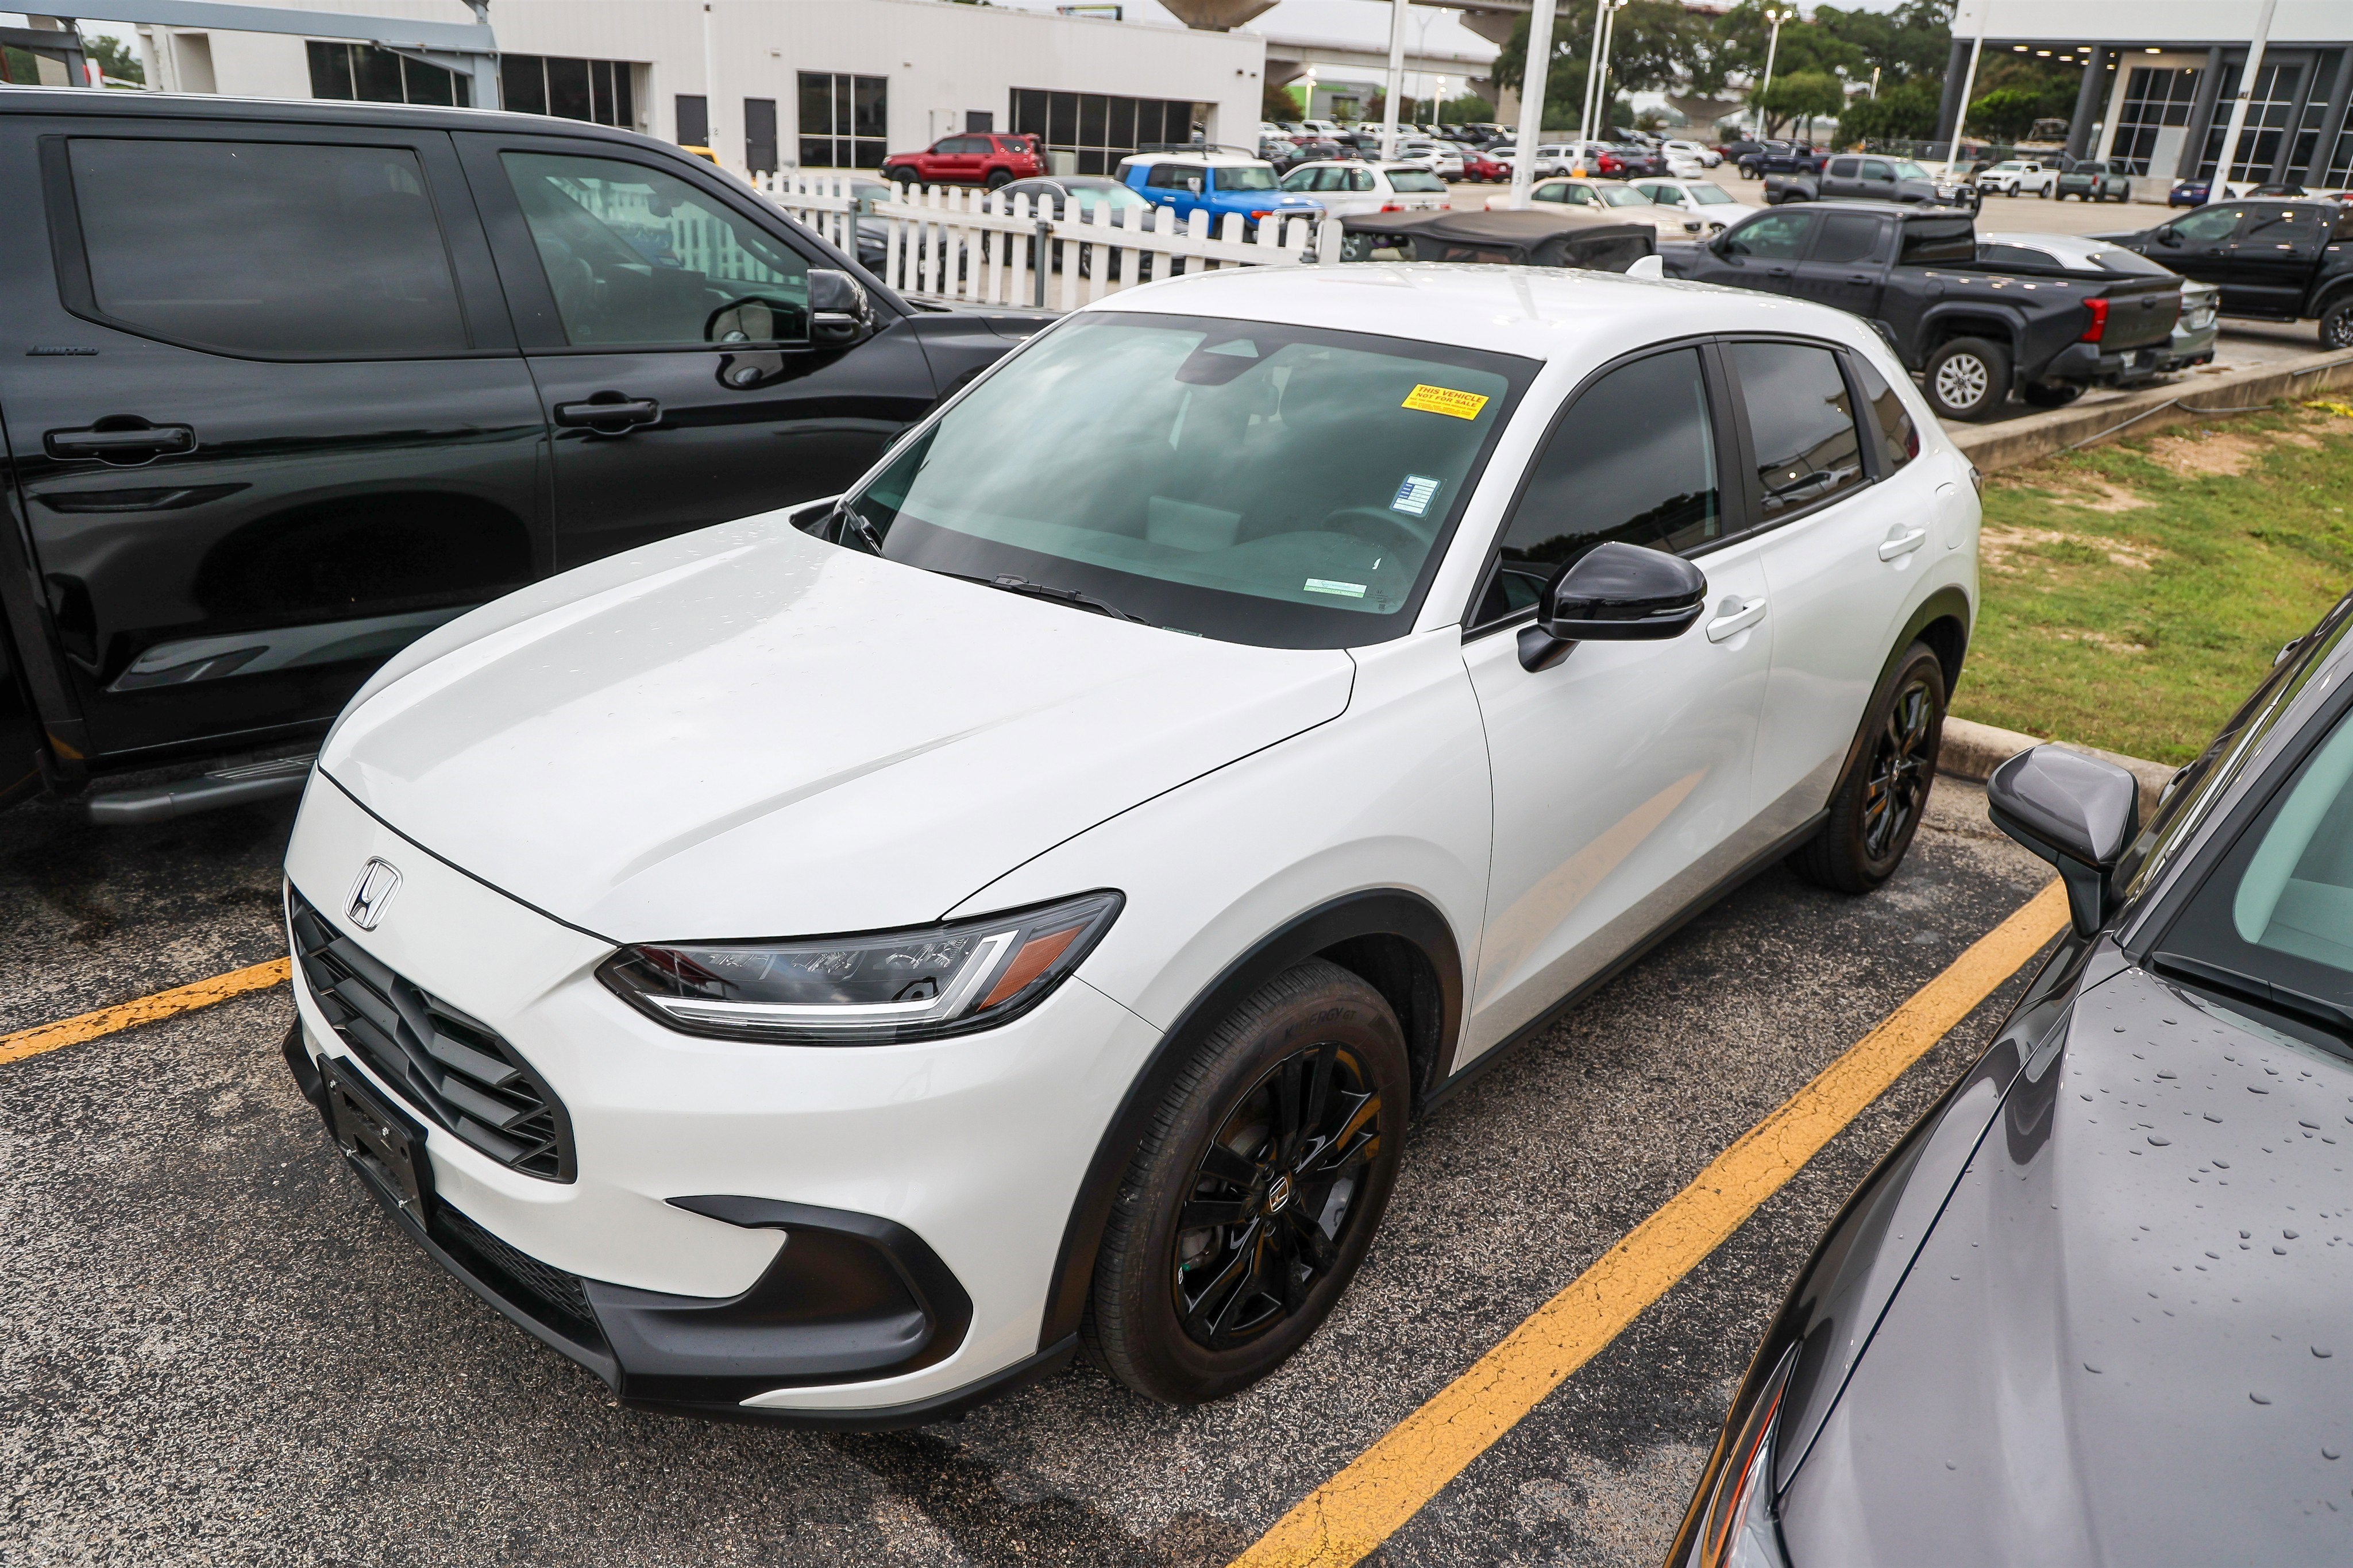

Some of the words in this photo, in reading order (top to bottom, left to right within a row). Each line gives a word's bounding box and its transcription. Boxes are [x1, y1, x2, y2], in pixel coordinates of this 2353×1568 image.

[1418, 386, 1440, 394] THIS
[1442, 389, 1484, 403] VEHICLE
[1455, 399, 1478, 407] SALE
[1342, 1010, 1357, 1021] GT
